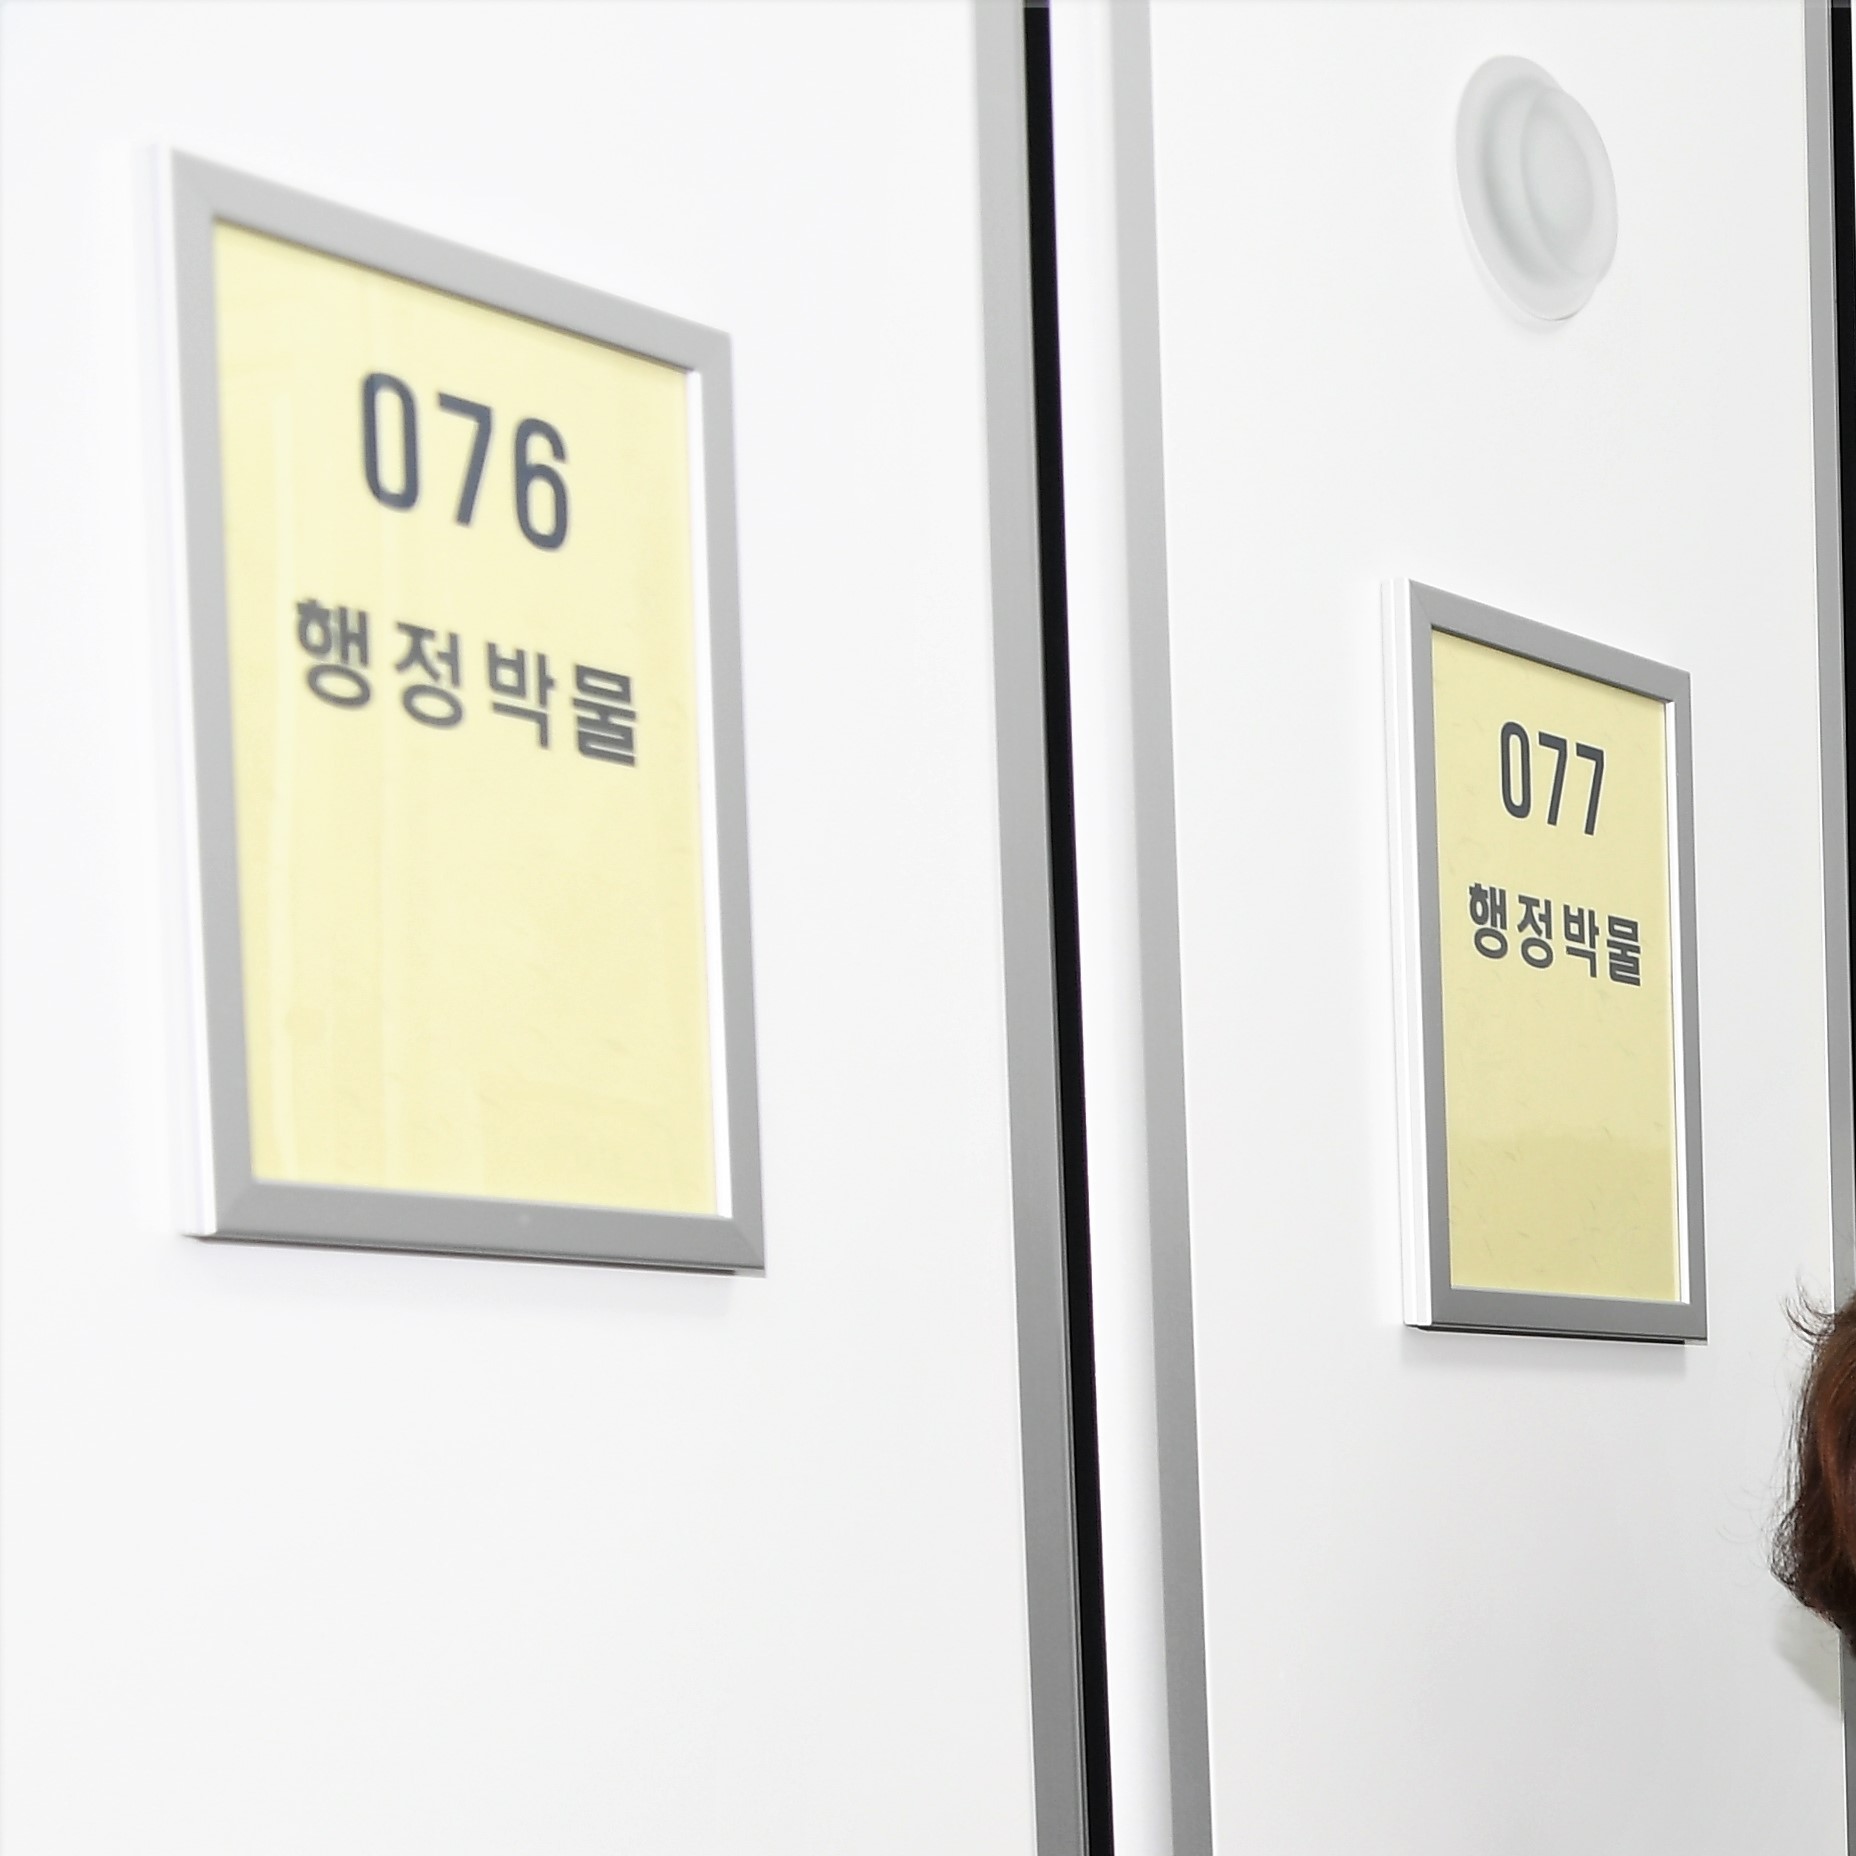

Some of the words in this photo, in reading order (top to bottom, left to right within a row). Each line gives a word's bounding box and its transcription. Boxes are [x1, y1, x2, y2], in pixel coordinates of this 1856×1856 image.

[358, 370, 573, 552] 076
[294, 594, 640, 767] 행정박물
[1499, 721, 1606, 837] 077
[1467, 881, 1642, 987] 행정박물
